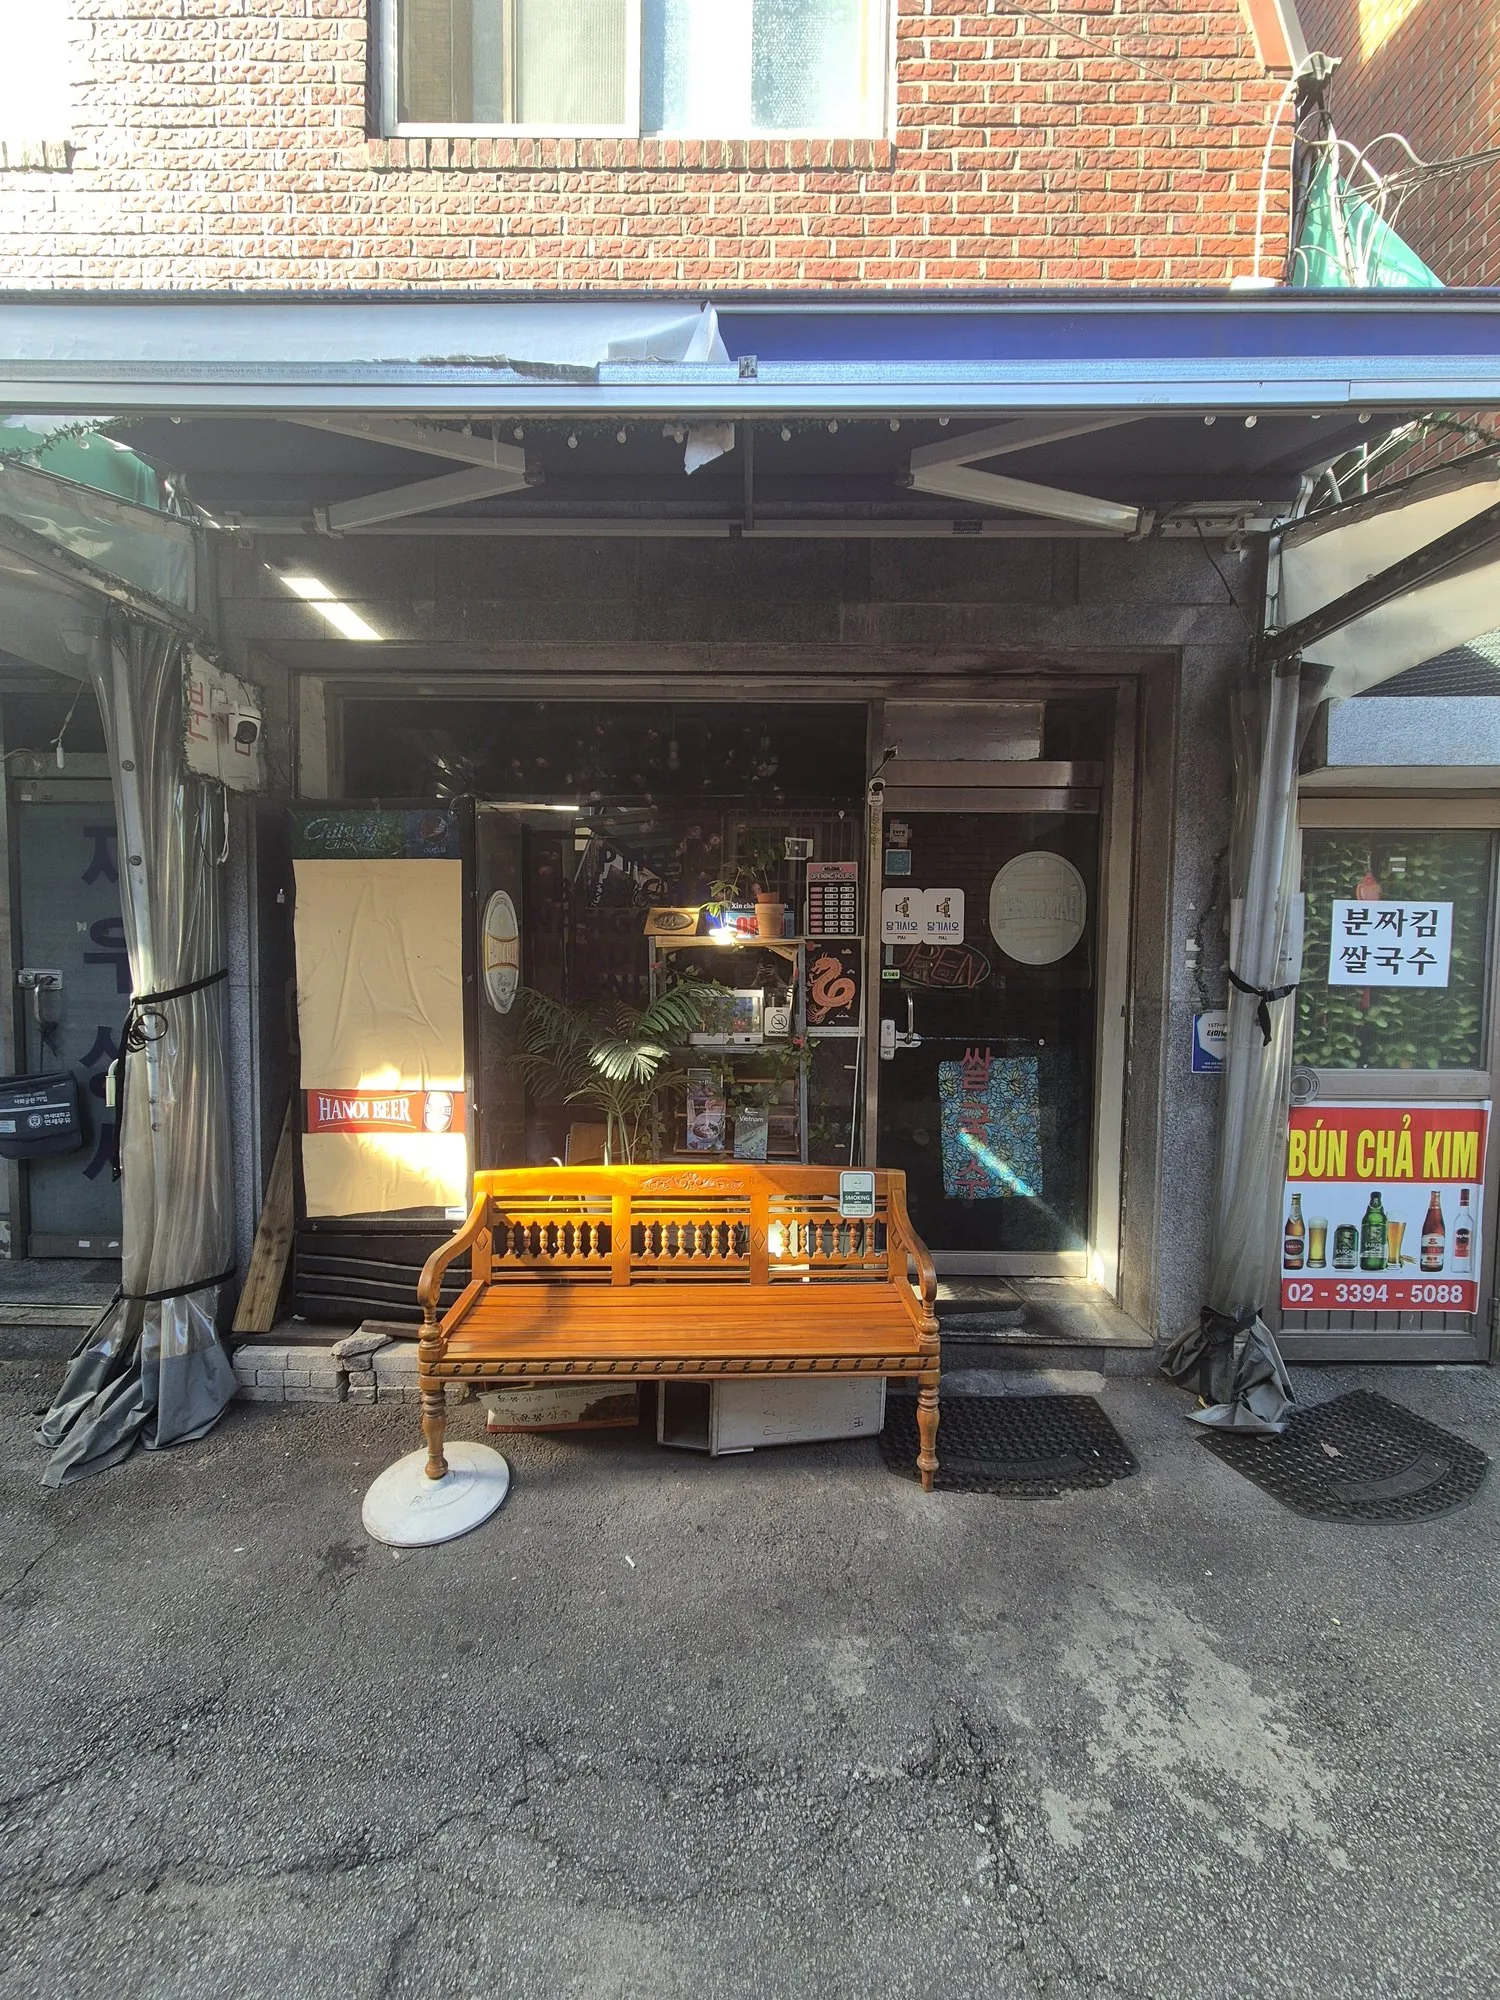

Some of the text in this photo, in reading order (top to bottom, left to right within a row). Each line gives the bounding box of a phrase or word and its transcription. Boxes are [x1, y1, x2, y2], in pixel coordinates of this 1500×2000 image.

[1342, 908, 1439, 938] 분짜킴
[1339, 945, 1439, 977] 쌀국수
[43, 1118, 72, 1126] 연세우유
[318, 1096, 369, 1122] HANOI
[372, 1097, 412, 1122] BEER
[954, 1047, 993, 1200] 쌀국수
[1288, 1113, 1478, 1179] BÚN CHẢ KIM
[1288, 1283, 1314, 1304] 02
[1335, 1283, 1389, 1304] 3394
[1410, 1284, 1463, 1304] 5088
